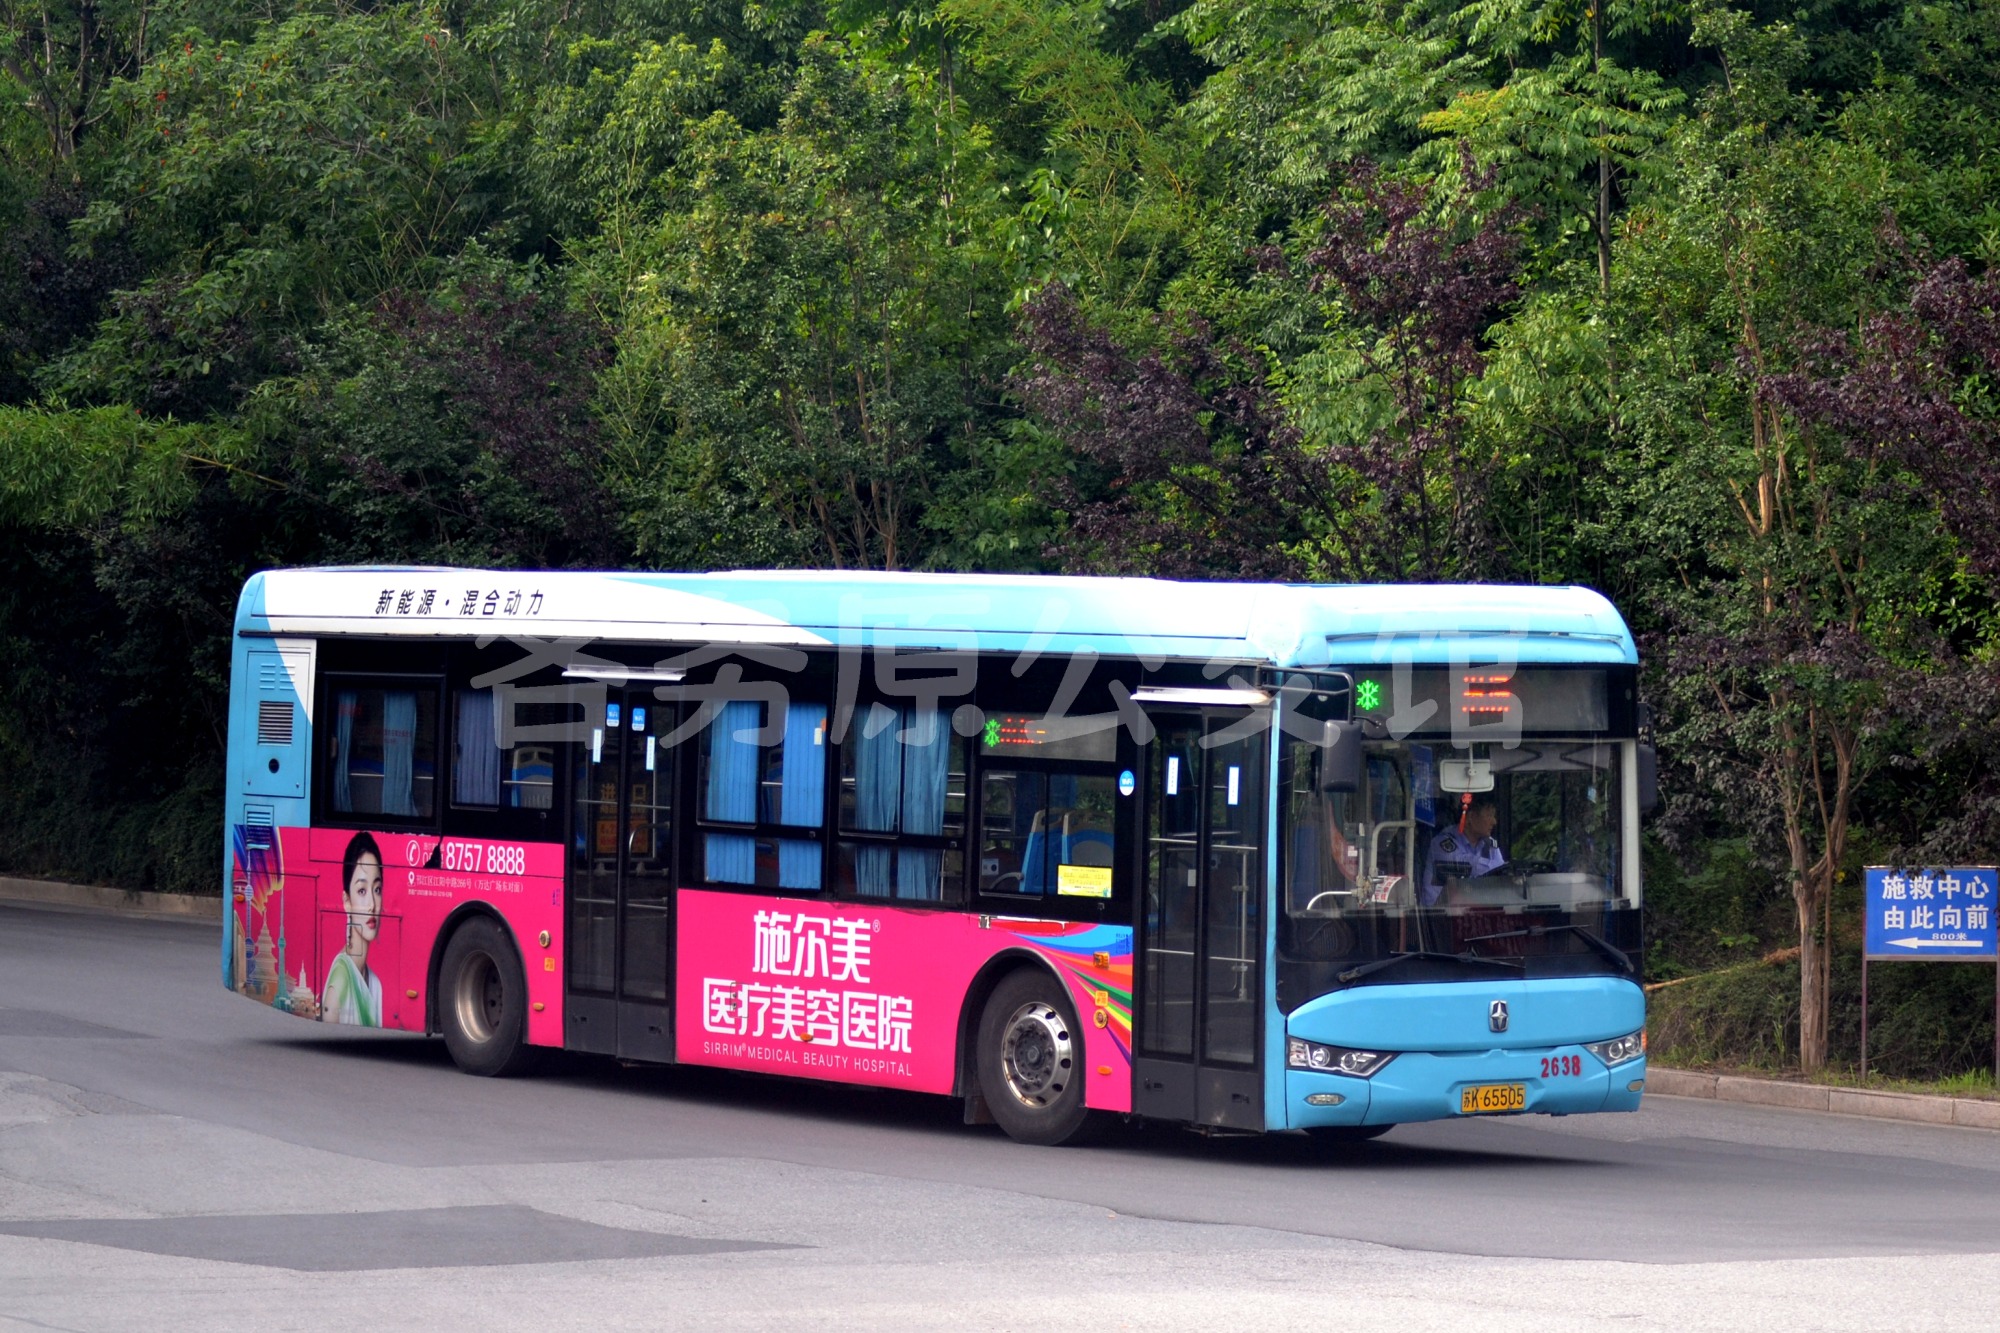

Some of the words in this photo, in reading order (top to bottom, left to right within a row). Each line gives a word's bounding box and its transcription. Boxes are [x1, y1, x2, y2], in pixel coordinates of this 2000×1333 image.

[445, 841, 483, 872] 8757
[486, 845, 526, 876] 8888
[1881, 875, 1990, 900] 施救中心
[1883, 904, 1990, 930] 由此向前
[1931, 932, 1968, 941] 800米
[703, 977, 913, 1054] 医疗美容医院
[747, 1045, 798, 1064] MEDICAL
[803, 1051, 849, 1069] BEAUTY
[854, 1057, 913, 1077] HOSPITAL
[1541, 1055, 1581, 1079] 2638
